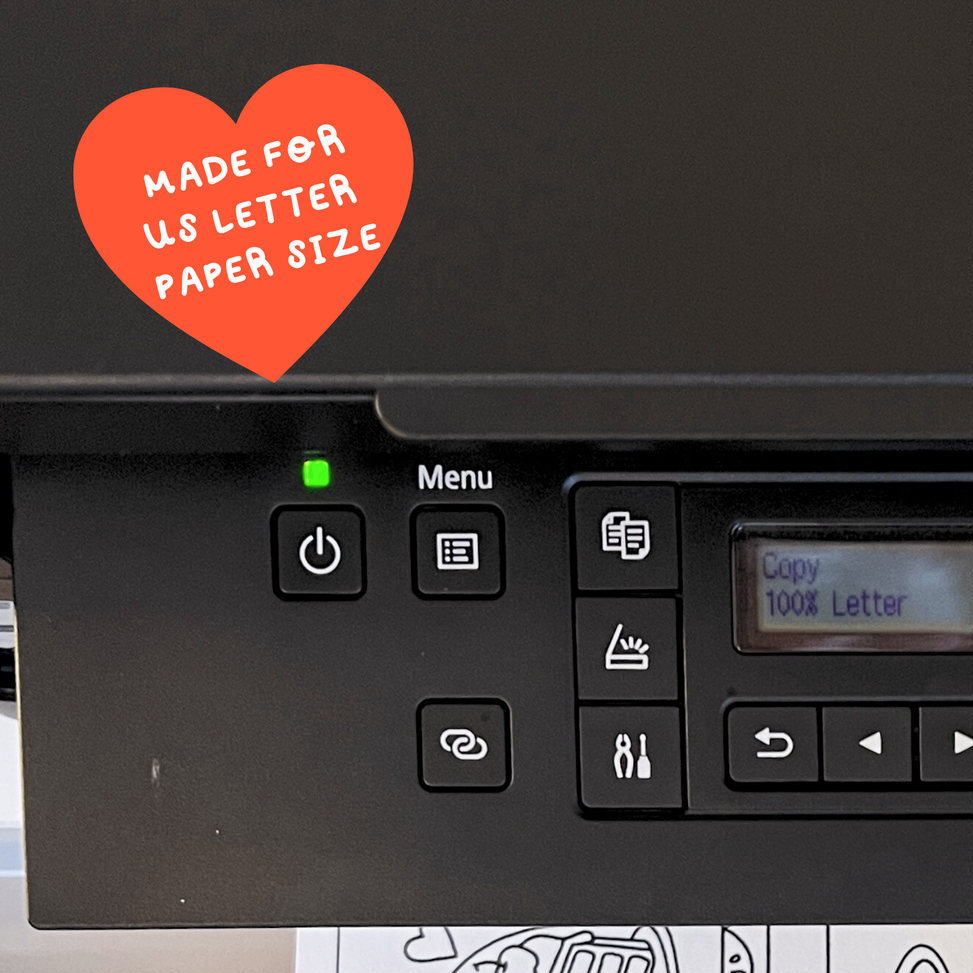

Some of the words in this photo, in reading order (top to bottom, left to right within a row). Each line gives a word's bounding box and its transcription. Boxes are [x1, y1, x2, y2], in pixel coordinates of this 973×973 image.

[418, 464, 493, 490] Menu
[762, 552, 820, 585] Copy
[765, 589, 819, 617] 100%
[831, 589, 908, 618] Letter
